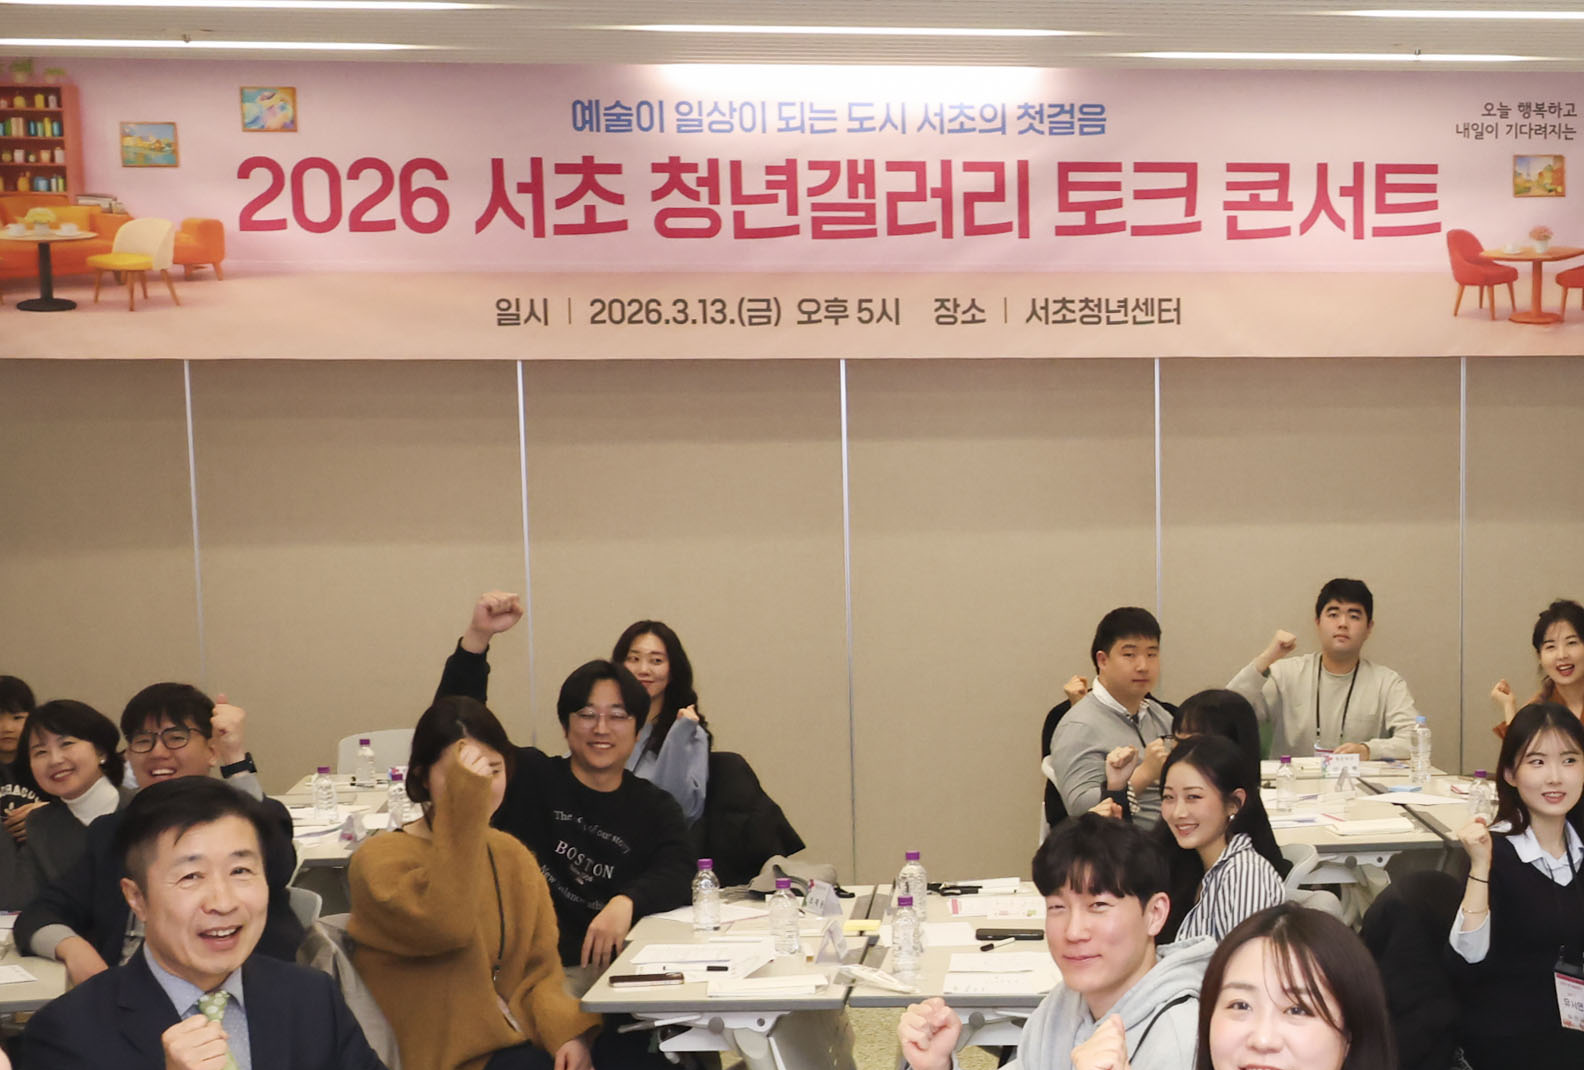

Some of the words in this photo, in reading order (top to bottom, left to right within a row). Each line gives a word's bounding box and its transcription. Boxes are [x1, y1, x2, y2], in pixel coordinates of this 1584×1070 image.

[573, 100, 664, 133] 예술이
[675, 101, 767, 134] 일상이
[777, 101, 838, 134] 되는
[847, 101, 907, 134] 도시
[918, 102, 1007, 135] 서초의
[1016, 102, 1107, 136] 첫걸음
[1480, 101, 1511, 120] 오늘
[1517, 101, 1578, 121] 행복하고
[1455, 121, 1499, 141] 내일이
[1504, 122, 1577, 142] 기다려지는
[236, 155, 452, 236] 2026
[474, 155, 629, 239] 서초
[649, 157, 1031, 242] 청년갤러리
[1053, 160, 1203, 239] 토크
[1221, 160, 1443, 242] 콘서트
[494, 297, 549, 327] 일시
[589, 296, 783, 329] 2026.3.13.(금)
[796, 296, 850, 327] 오후
[855, 297, 902, 327] 5시
[932, 296, 988, 326] 장소
[1023, 296, 1183, 327] 서초청년센터
[555, 840, 614, 879] BOSTON
